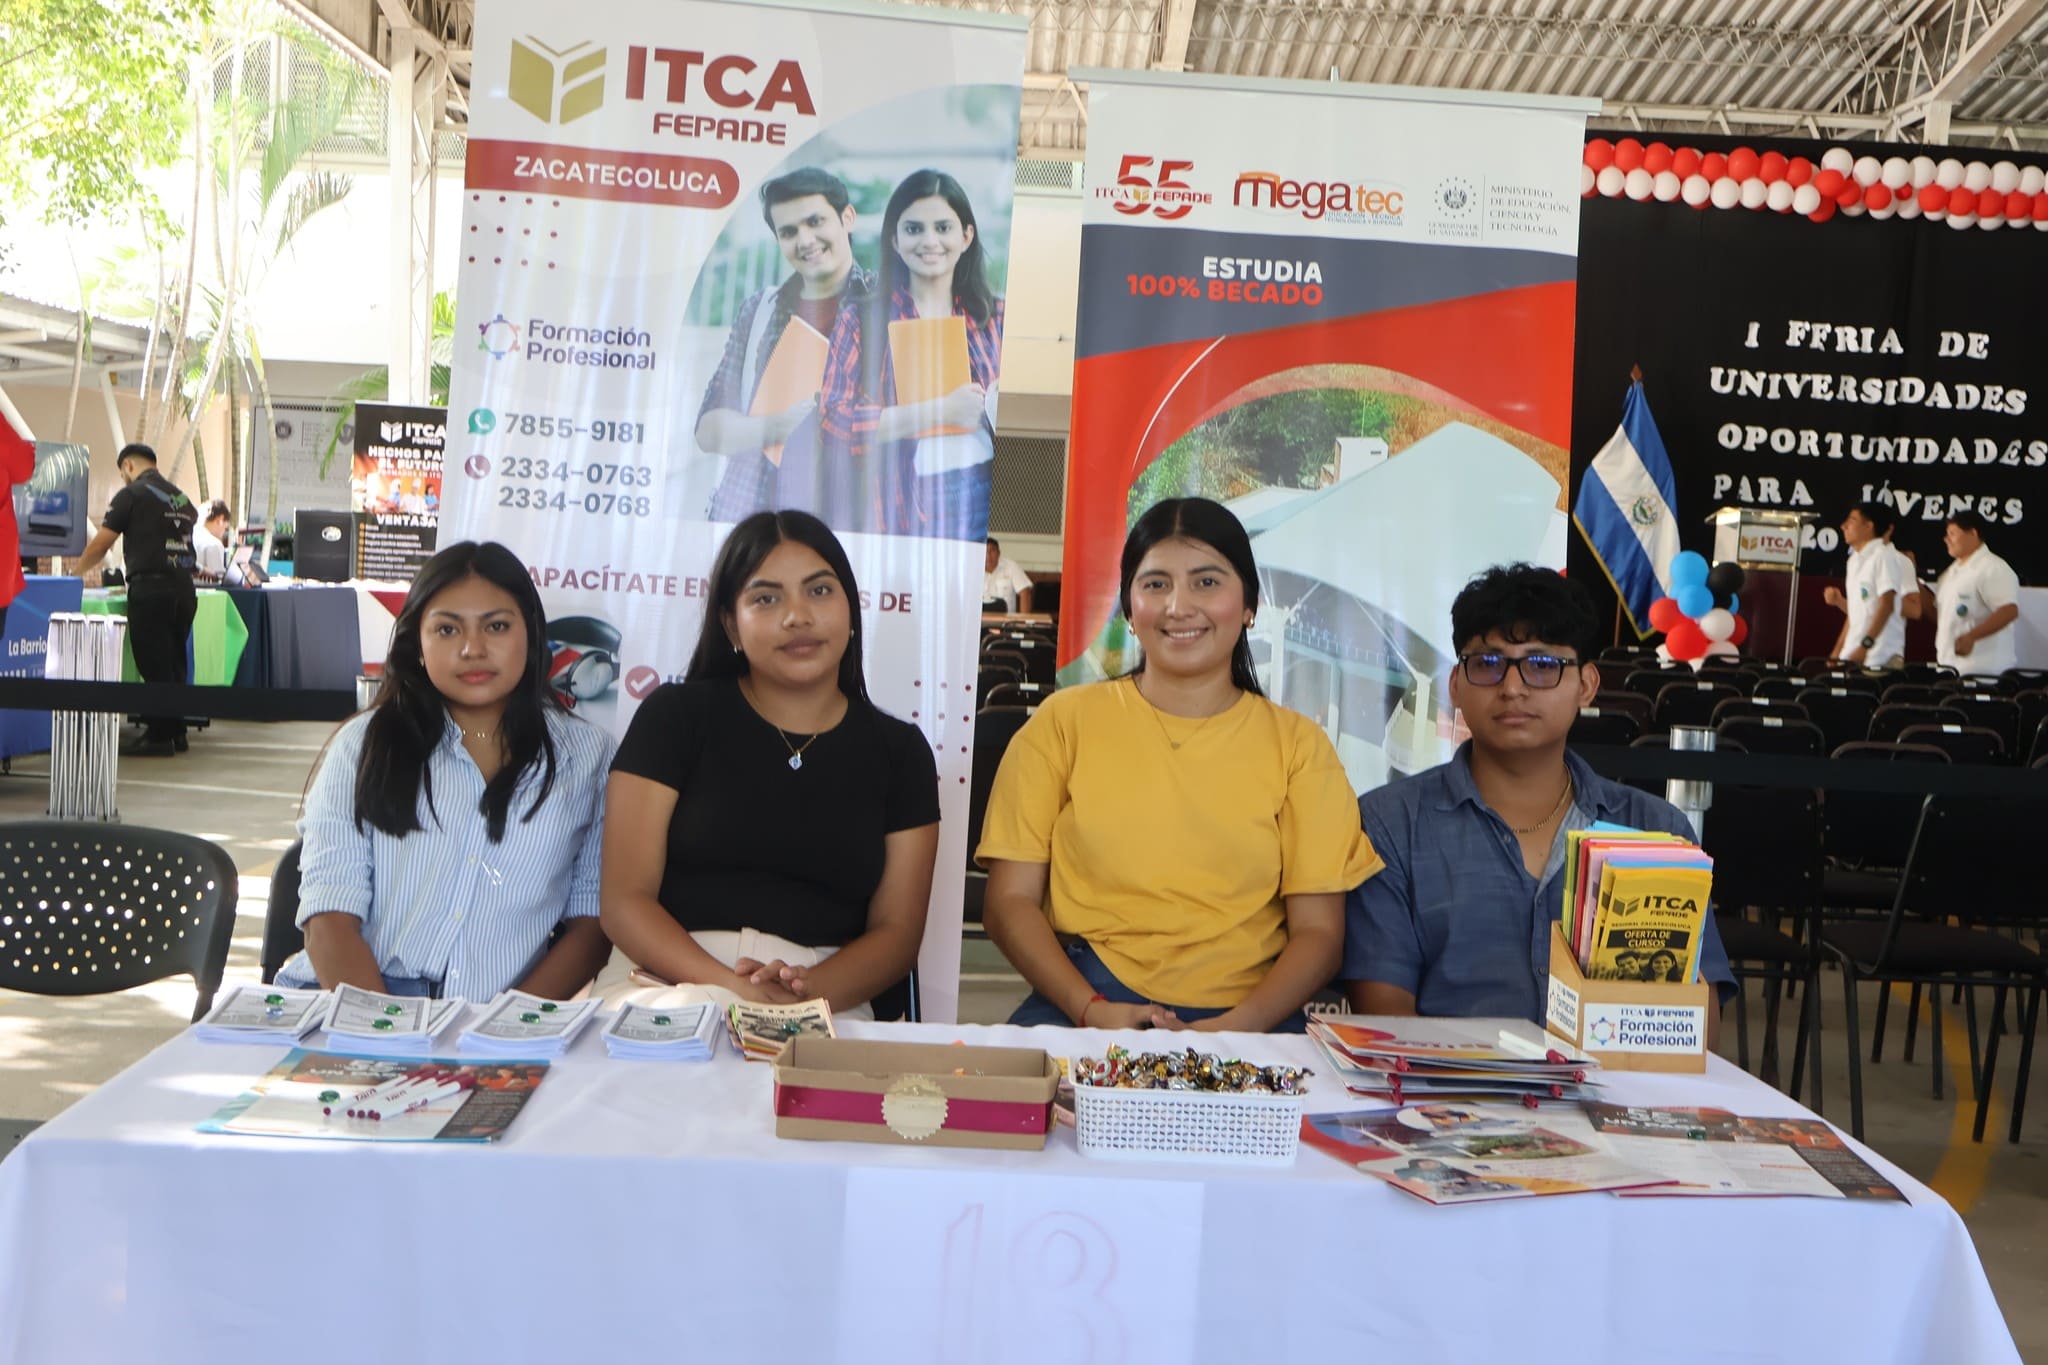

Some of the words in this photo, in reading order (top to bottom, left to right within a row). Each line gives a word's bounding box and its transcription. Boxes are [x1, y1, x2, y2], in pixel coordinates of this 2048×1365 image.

[625, 45, 817, 116] ITCA
[653, 112, 787, 145] FEPADE
[513, 155, 722, 194] ZACATECOLUCA
[1113, 155, 1194, 220] 55
[1095, 187, 1129, 200] ITCA
[1153, 191, 1213, 204] FEPADE
[1490, 184, 1553, 198] MINISTERIO
[1203, 256, 1323, 284] ESTUDIA
[1127, 274, 1200, 299] 100%
[1207, 279, 1323, 307] BECADO
[528, 318, 651, 347] Formación
[1938, 331, 1990, 359] DE
[526, 341, 656, 371] Profesional
[1710, 366, 2028, 415] UNIVERSIDADES
[405, 421, 447, 440] ITCA
[505, 412, 645, 444] 7855-9181
[1717, 422, 2048, 467] OPORTUNIDADES
[501, 456, 652, 487] 2334-0763
[499, 486, 651, 518] 2334-0768
[1713, 474, 1814, 505] PARA
[1760, 535, 1794, 548] ITCA
[527, 563, 678, 597] APACÍTATE
[879, 591, 913, 613] DE
[8, 639, 19, 657] La
[1643, 895, 1698, 913] ITCA
[1624, 930, 1657, 940] OFERTA
[1660, 931, 1672, 940] DE
[1628, 938, 1666, 949] CURSOS
[1620, 1018, 1694, 1033] Formación
[1621, 1007, 1643, 1017] ITCA
[1619, 1032, 1697, 1047] Profesional
